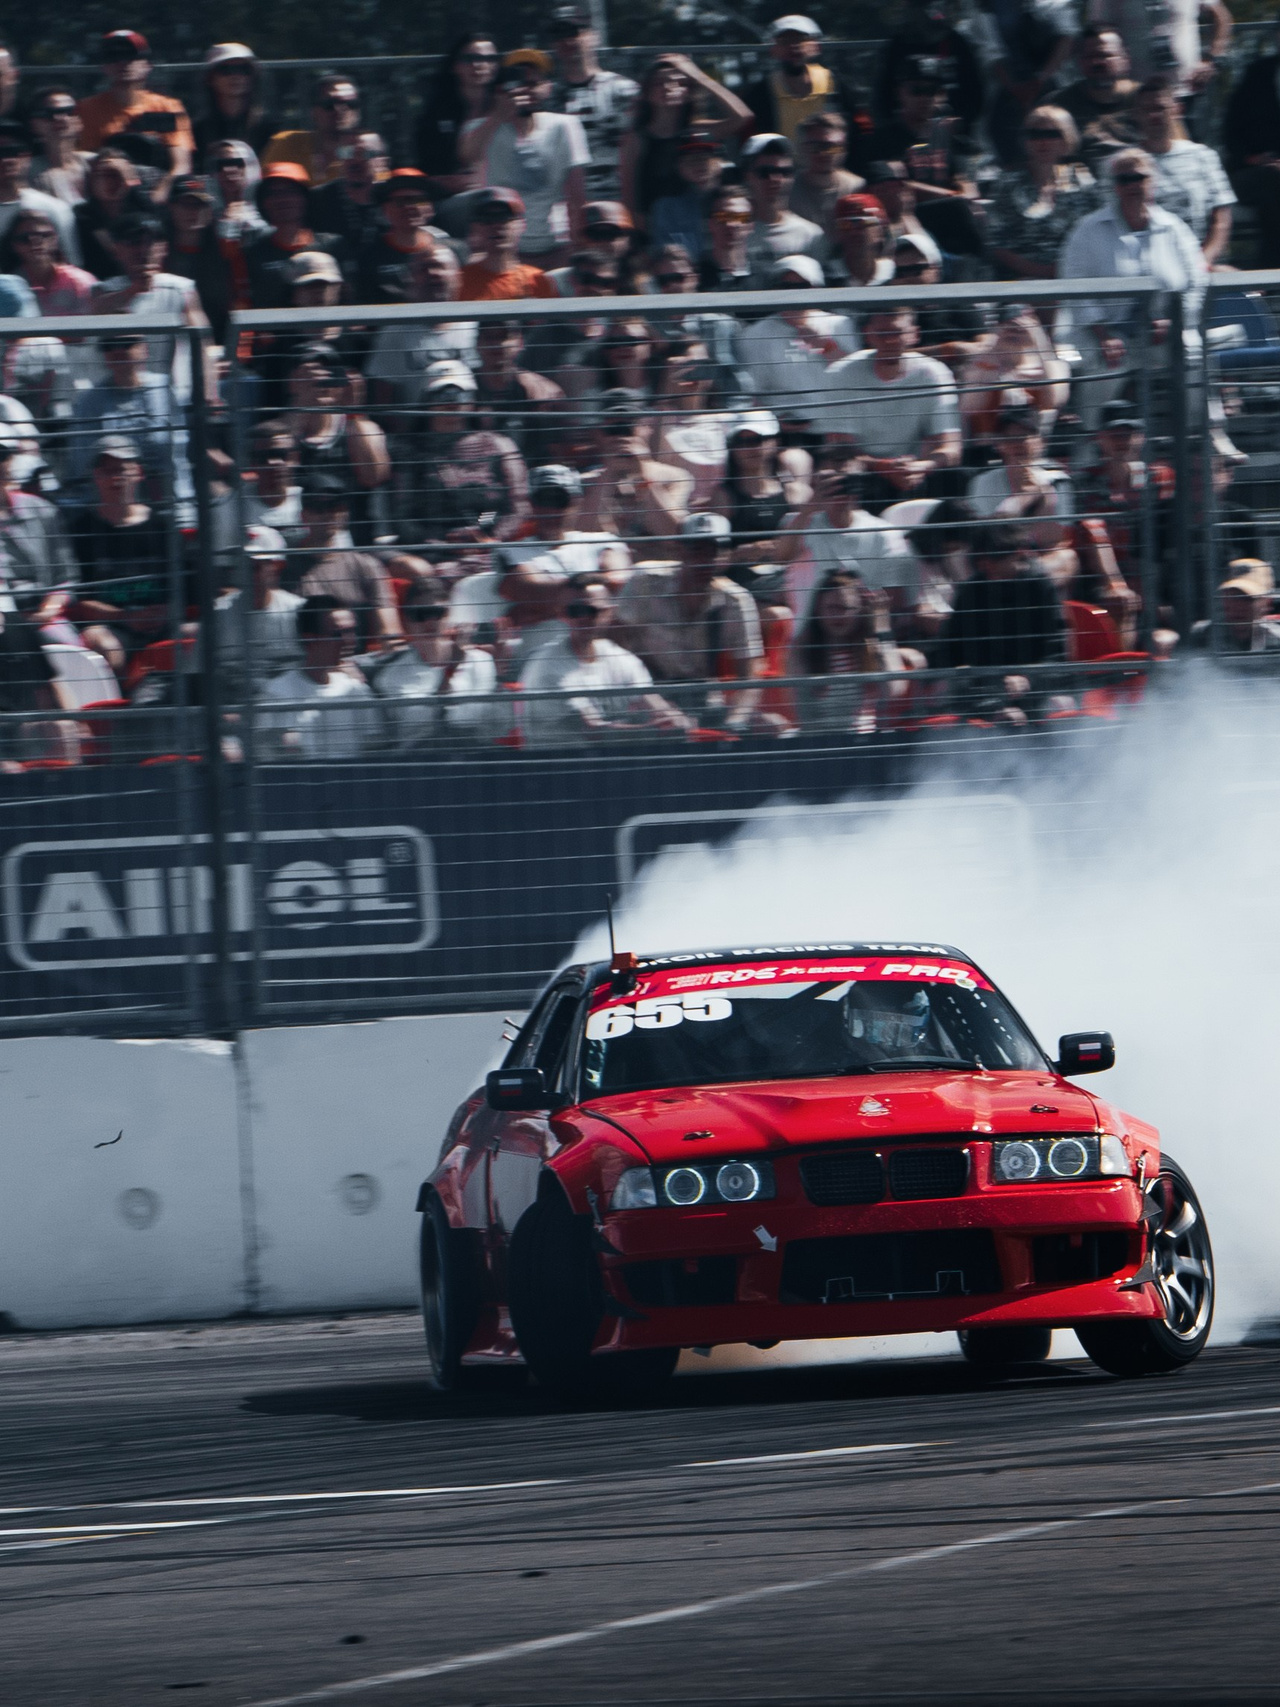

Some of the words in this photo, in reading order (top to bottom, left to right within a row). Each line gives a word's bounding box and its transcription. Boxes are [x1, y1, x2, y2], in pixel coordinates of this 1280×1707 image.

[731, 944, 854, 956] RACING
[862, 944, 949, 955] TEAM
[710, 967, 779, 984] RDS
[881, 963, 970, 979] PRO
[585, 991, 733, 1041] 655
